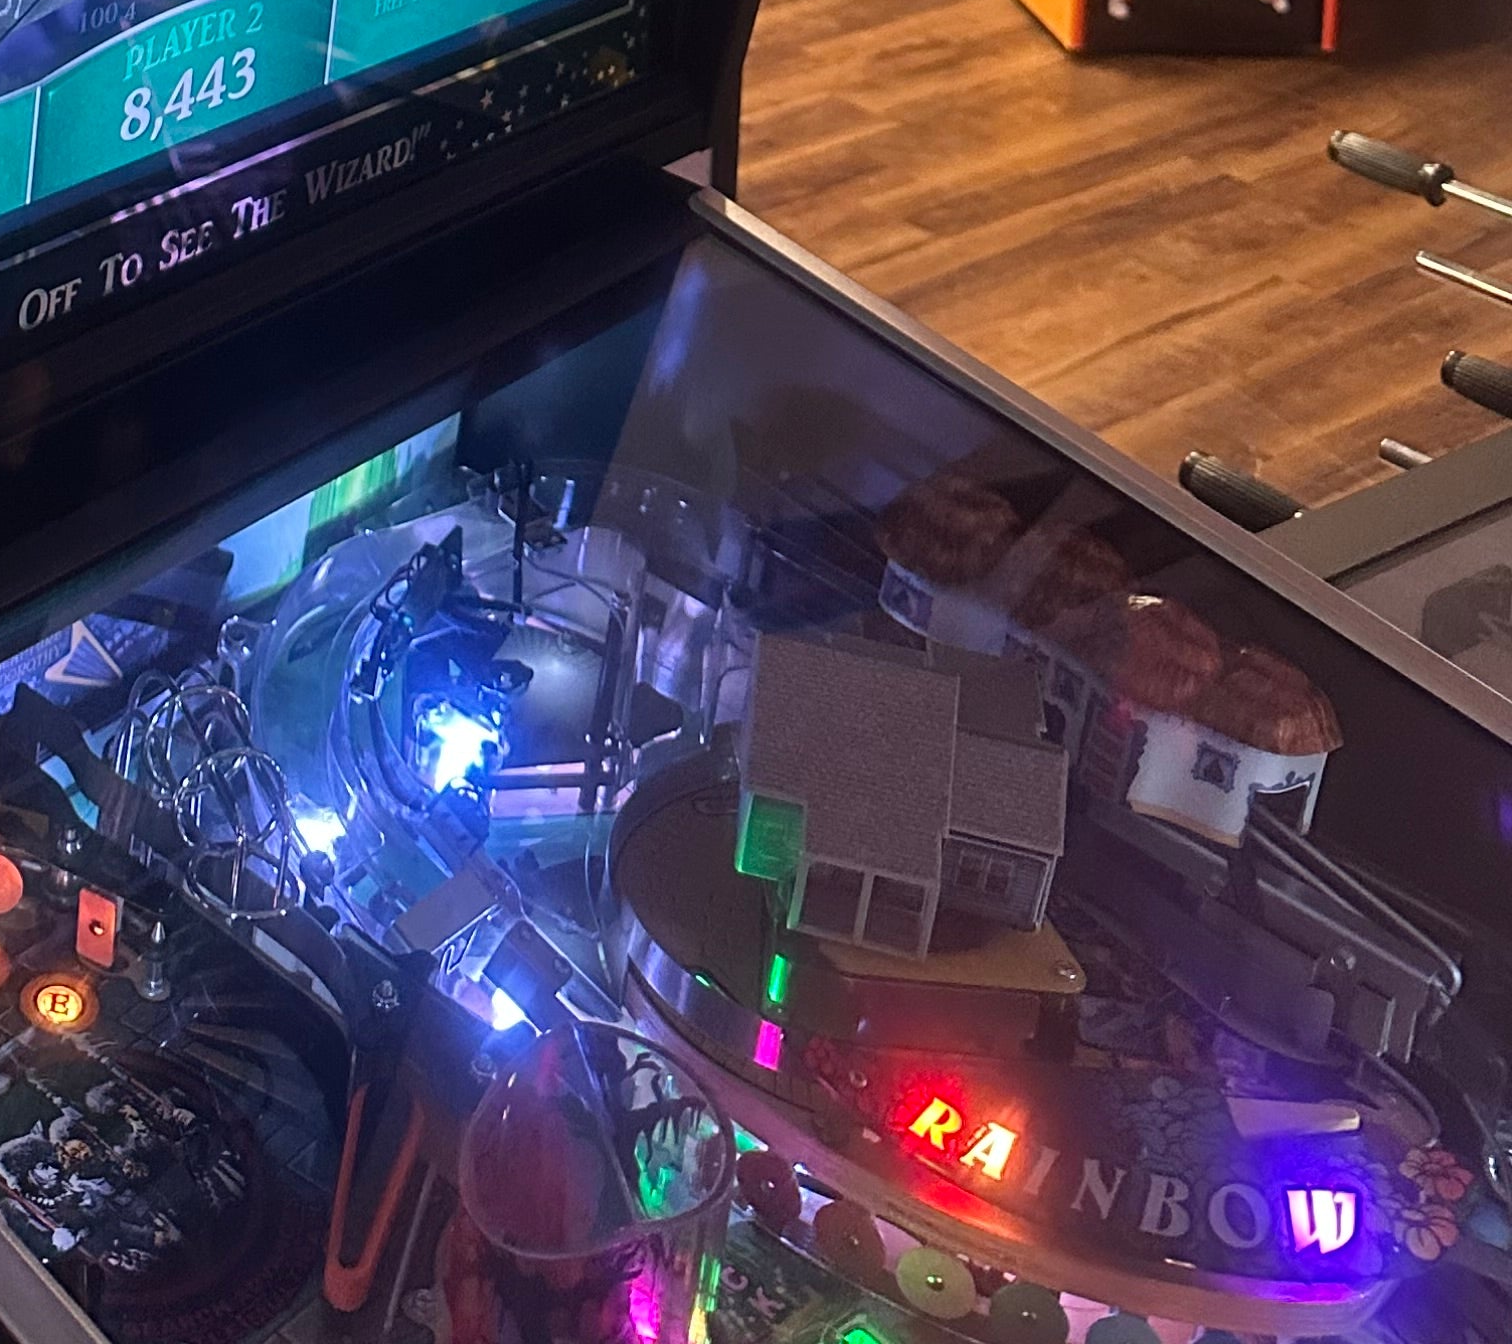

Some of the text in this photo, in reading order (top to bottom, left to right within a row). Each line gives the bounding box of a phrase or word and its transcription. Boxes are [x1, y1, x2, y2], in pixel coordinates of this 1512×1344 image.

[121, 0, 265, 83] PLAYER 2
[118, 46, 257, 143] 8,443
[17, 275, 84, 333] OFF
[99, 251, 144, 297] TO
[158, 219, 216, 274] SEE
[231, 187, 288, 241] THE
[48, 992, 70, 1016] E
[908, 1095, 1358, 1257] RAINBOW
